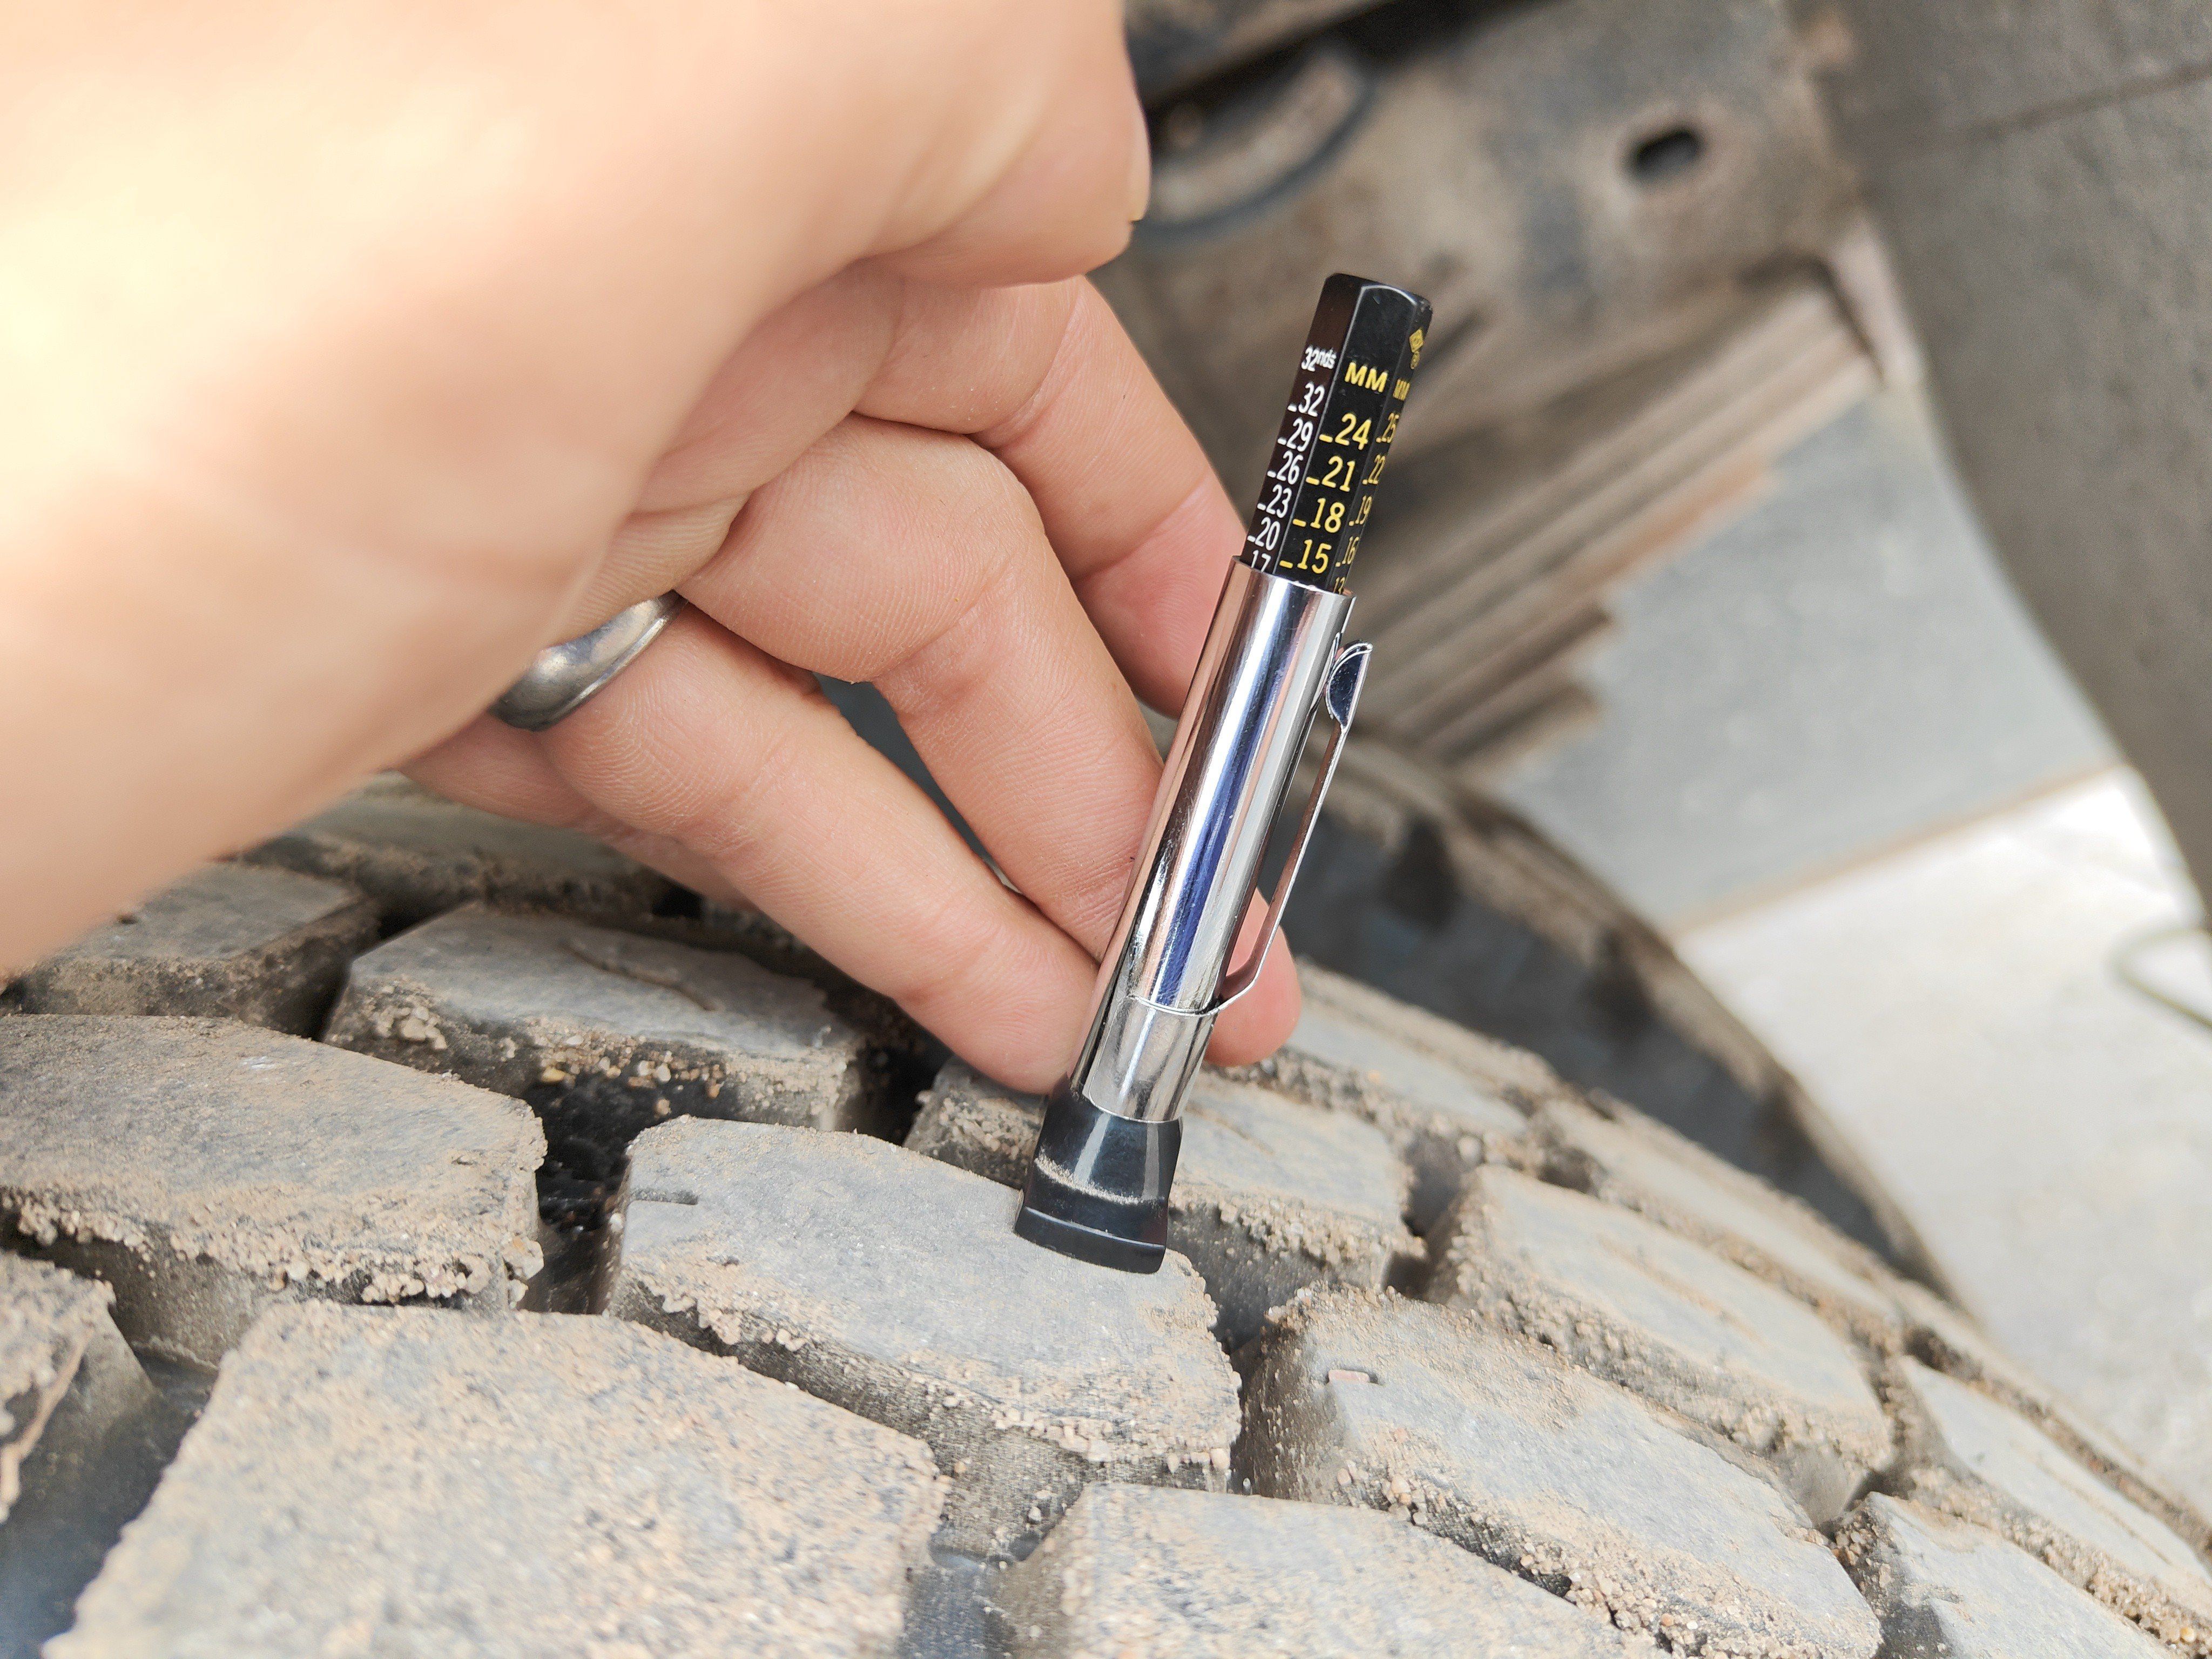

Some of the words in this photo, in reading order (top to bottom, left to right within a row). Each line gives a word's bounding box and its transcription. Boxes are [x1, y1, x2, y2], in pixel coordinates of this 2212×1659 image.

[1345, 361, 1388, 392] MM
[1299, 381, 1325, 416] 32
[1286, 417, 1313, 451] 29
[1335, 413, 1371, 450] 24
[1277, 450, 1304, 484] 26
[1322, 456, 1355, 491] 21
[1266, 484, 1292, 518] 23
[1311, 498, 1345, 533] 18
[1255, 517, 1280, 550] 20
[1297, 539, 1331, 574] 15
